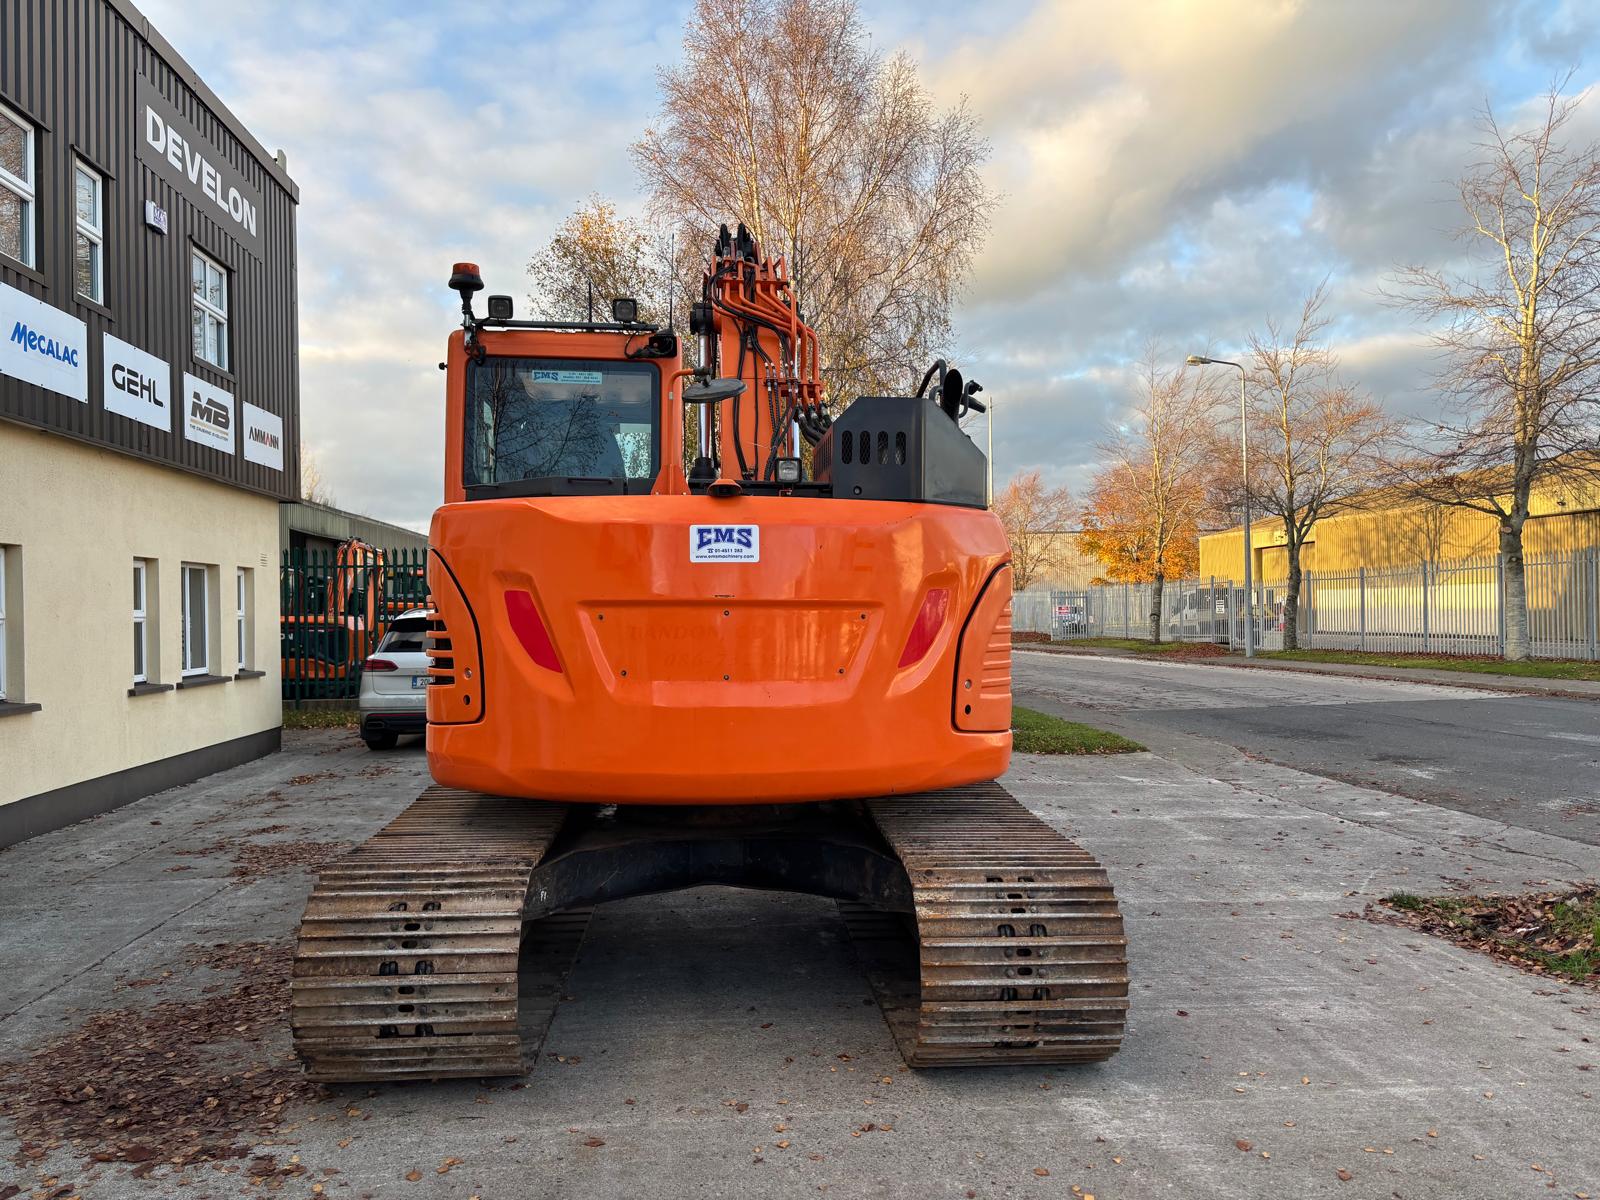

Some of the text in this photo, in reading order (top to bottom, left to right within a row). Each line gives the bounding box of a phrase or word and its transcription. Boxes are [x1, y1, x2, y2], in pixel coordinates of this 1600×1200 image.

[146, 105, 257, 237] DEVELON
[112, 363, 164, 408] GEHL
[533, 371, 559, 381] EMS
[191, 391, 230, 430] MB
[249, 426, 279, 450] AMMANN
[697, 528, 752, 550] EMS
